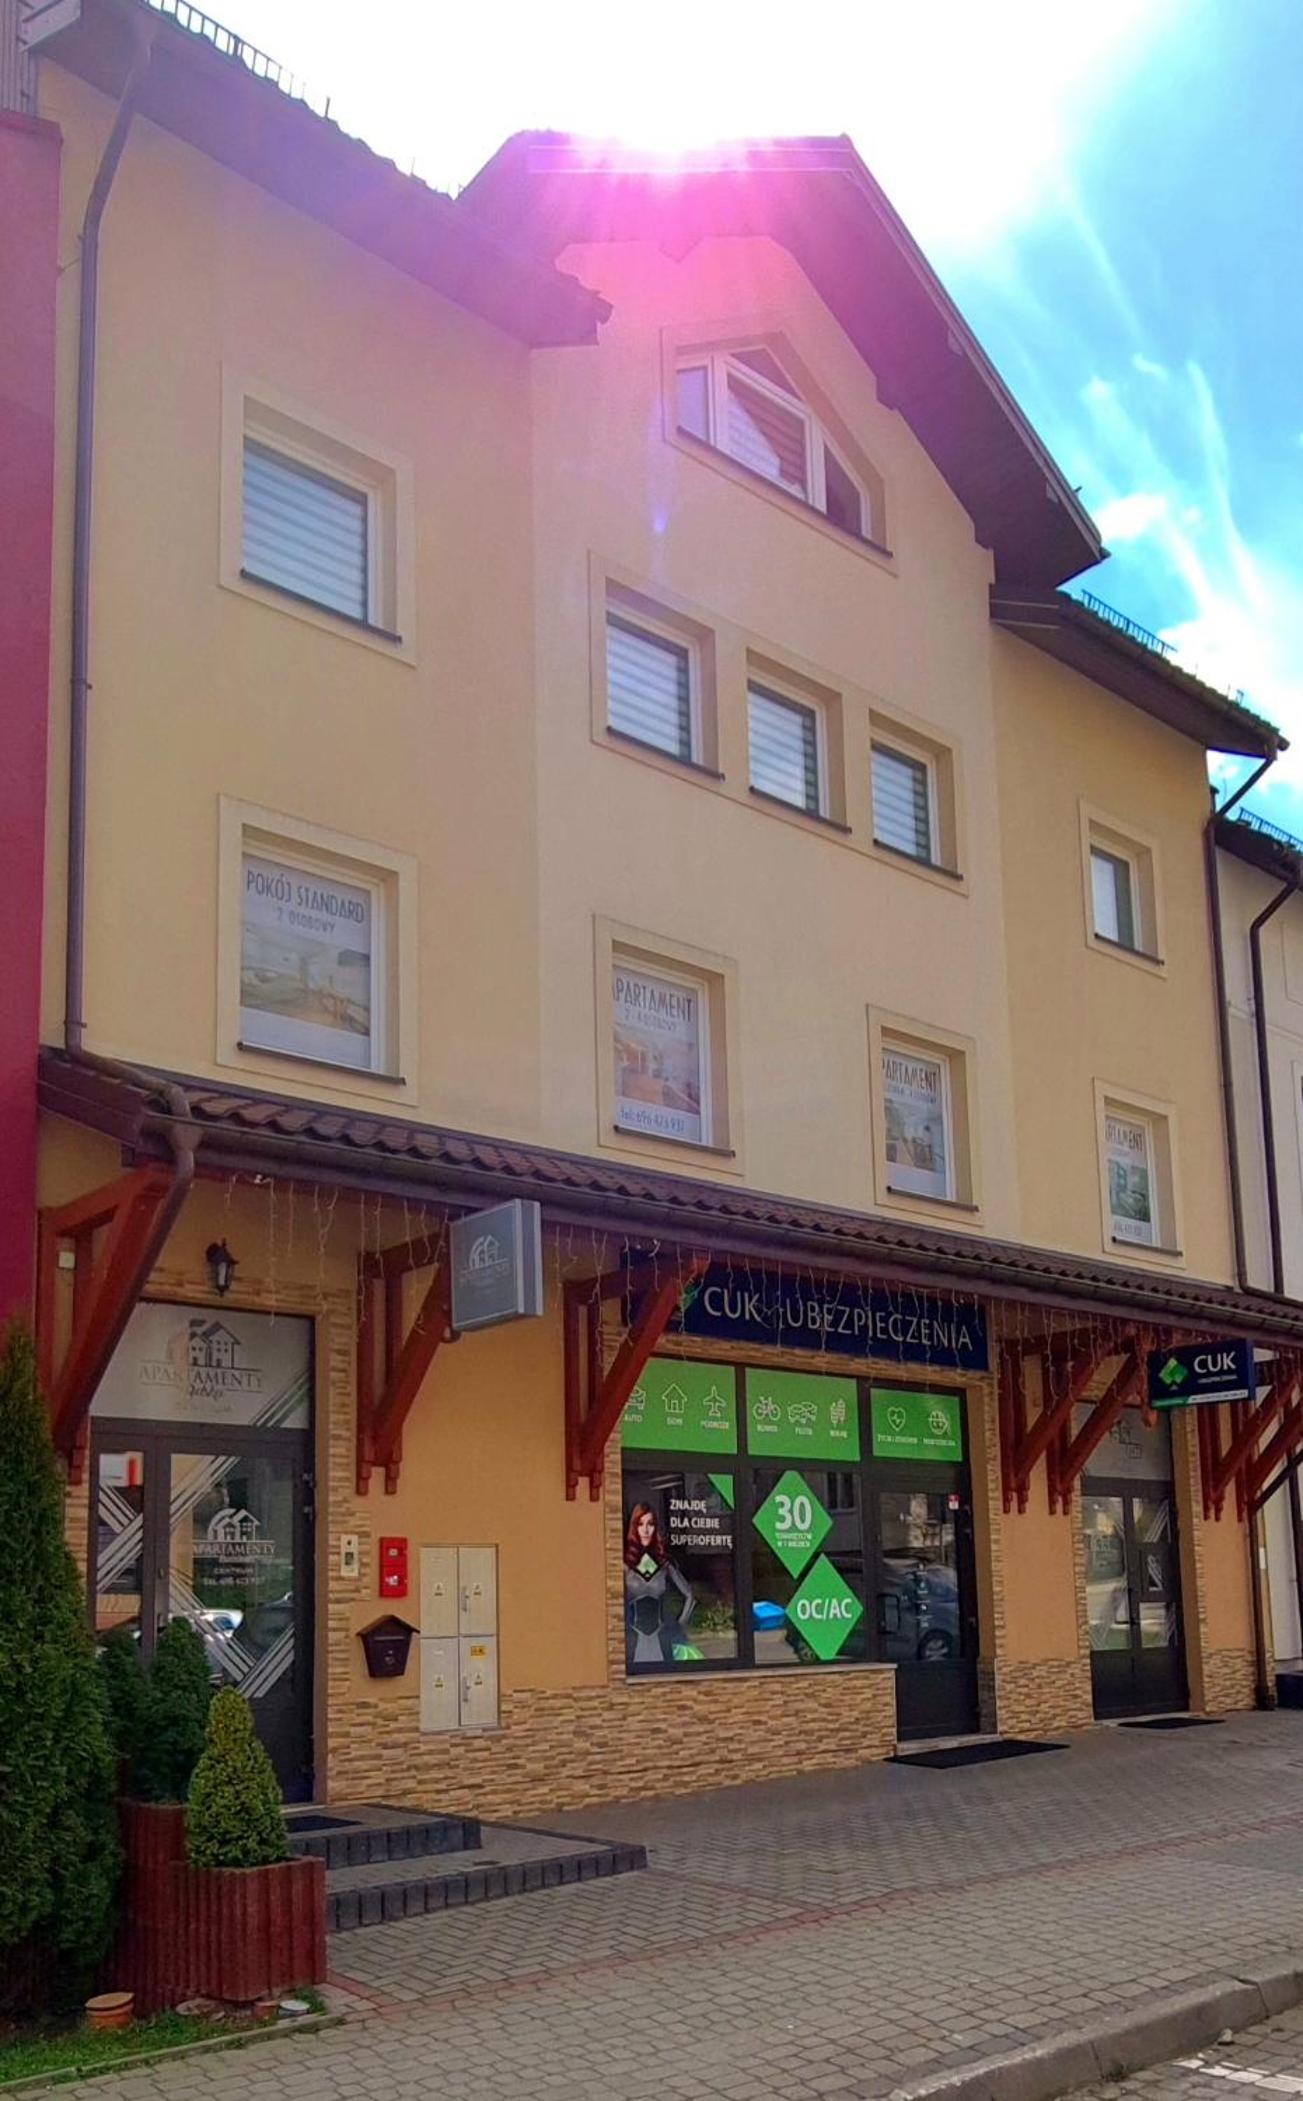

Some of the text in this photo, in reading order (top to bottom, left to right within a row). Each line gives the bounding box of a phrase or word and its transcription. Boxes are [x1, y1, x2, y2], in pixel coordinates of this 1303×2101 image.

[246, 869, 365, 924] POKÓJ STANDARD
[613, 977, 692, 1022] PARTAMENT
[703, 1286, 973, 1352] CUK UBEZPIECZENIA
[1193, 1351, 1237, 1374] CUK
[670, 1498, 707, 1514] ZNAJDĘ
[774, 1494, 812, 1531] 30
[670, 1516, 720, 1529] DLA CIEBIE
[670, 1534, 732, 1550] SUPEROFERTĘ
[797, 1598, 853, 1621] OC/AC
